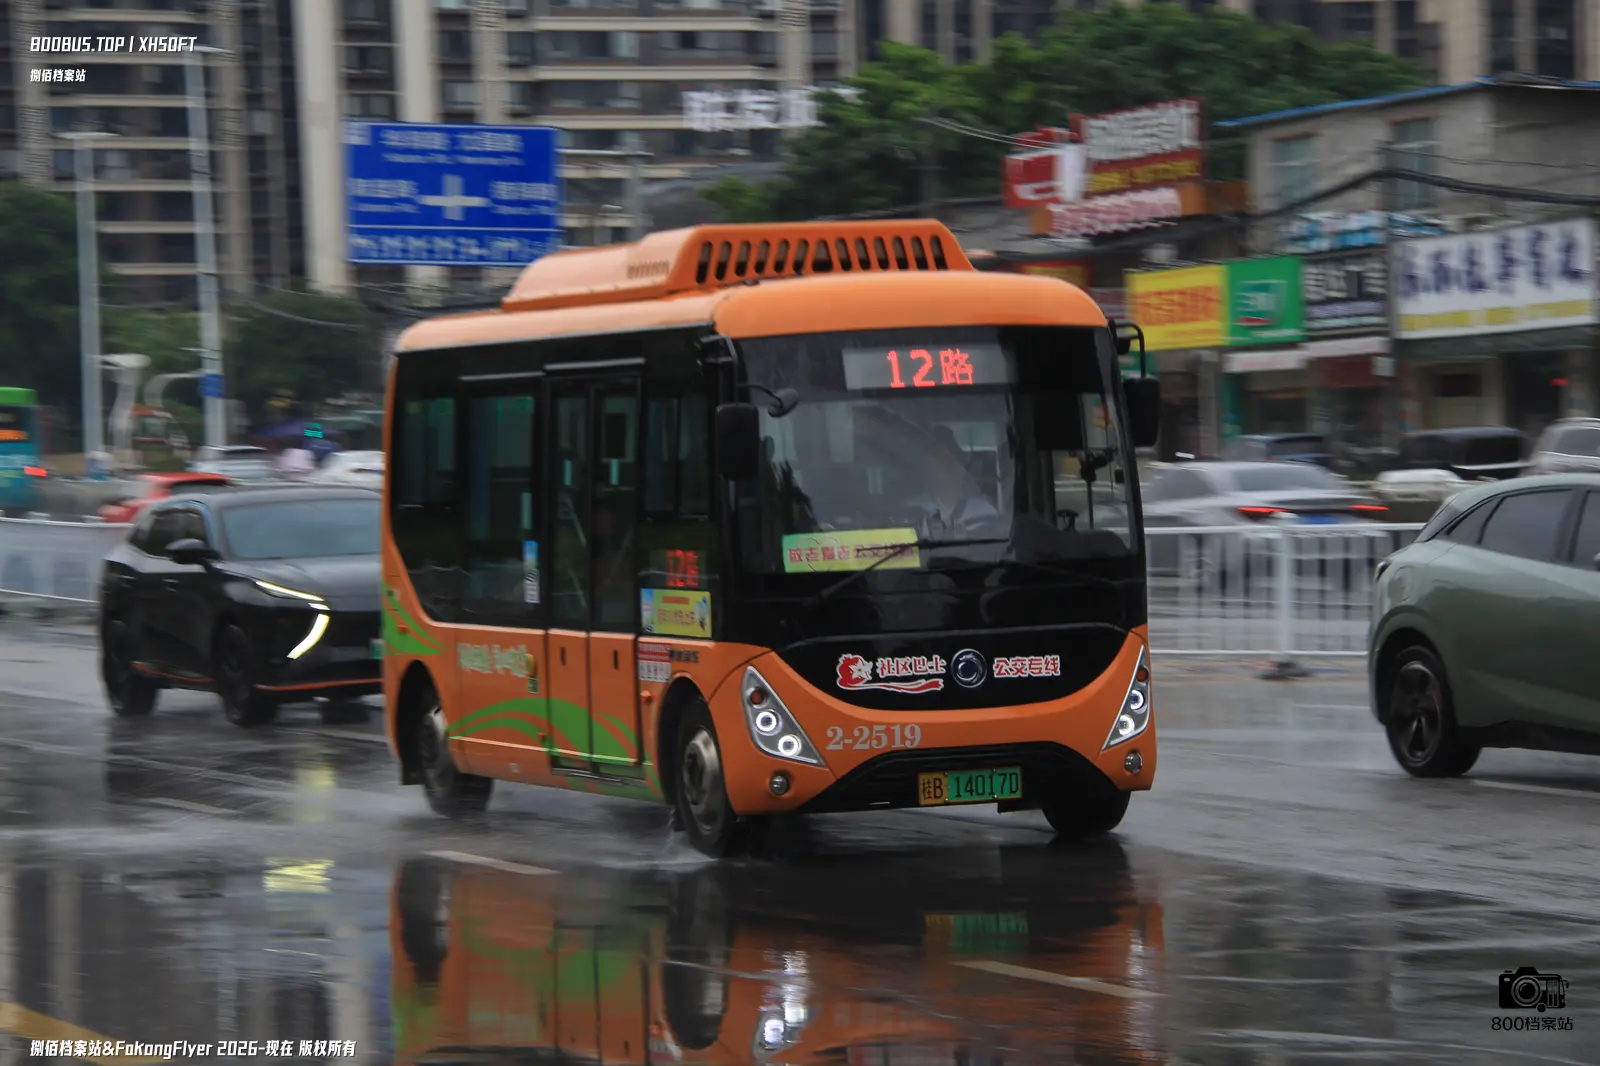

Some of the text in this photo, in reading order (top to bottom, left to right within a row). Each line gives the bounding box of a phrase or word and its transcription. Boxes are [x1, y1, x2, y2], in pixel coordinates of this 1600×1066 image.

[887, 348, 973, 388] 12路
[876, 654, 947, 678] 社区巴士
[993, 655, 1061, 678] 公交专线
[826, 723, 922, 750] 2-2519
